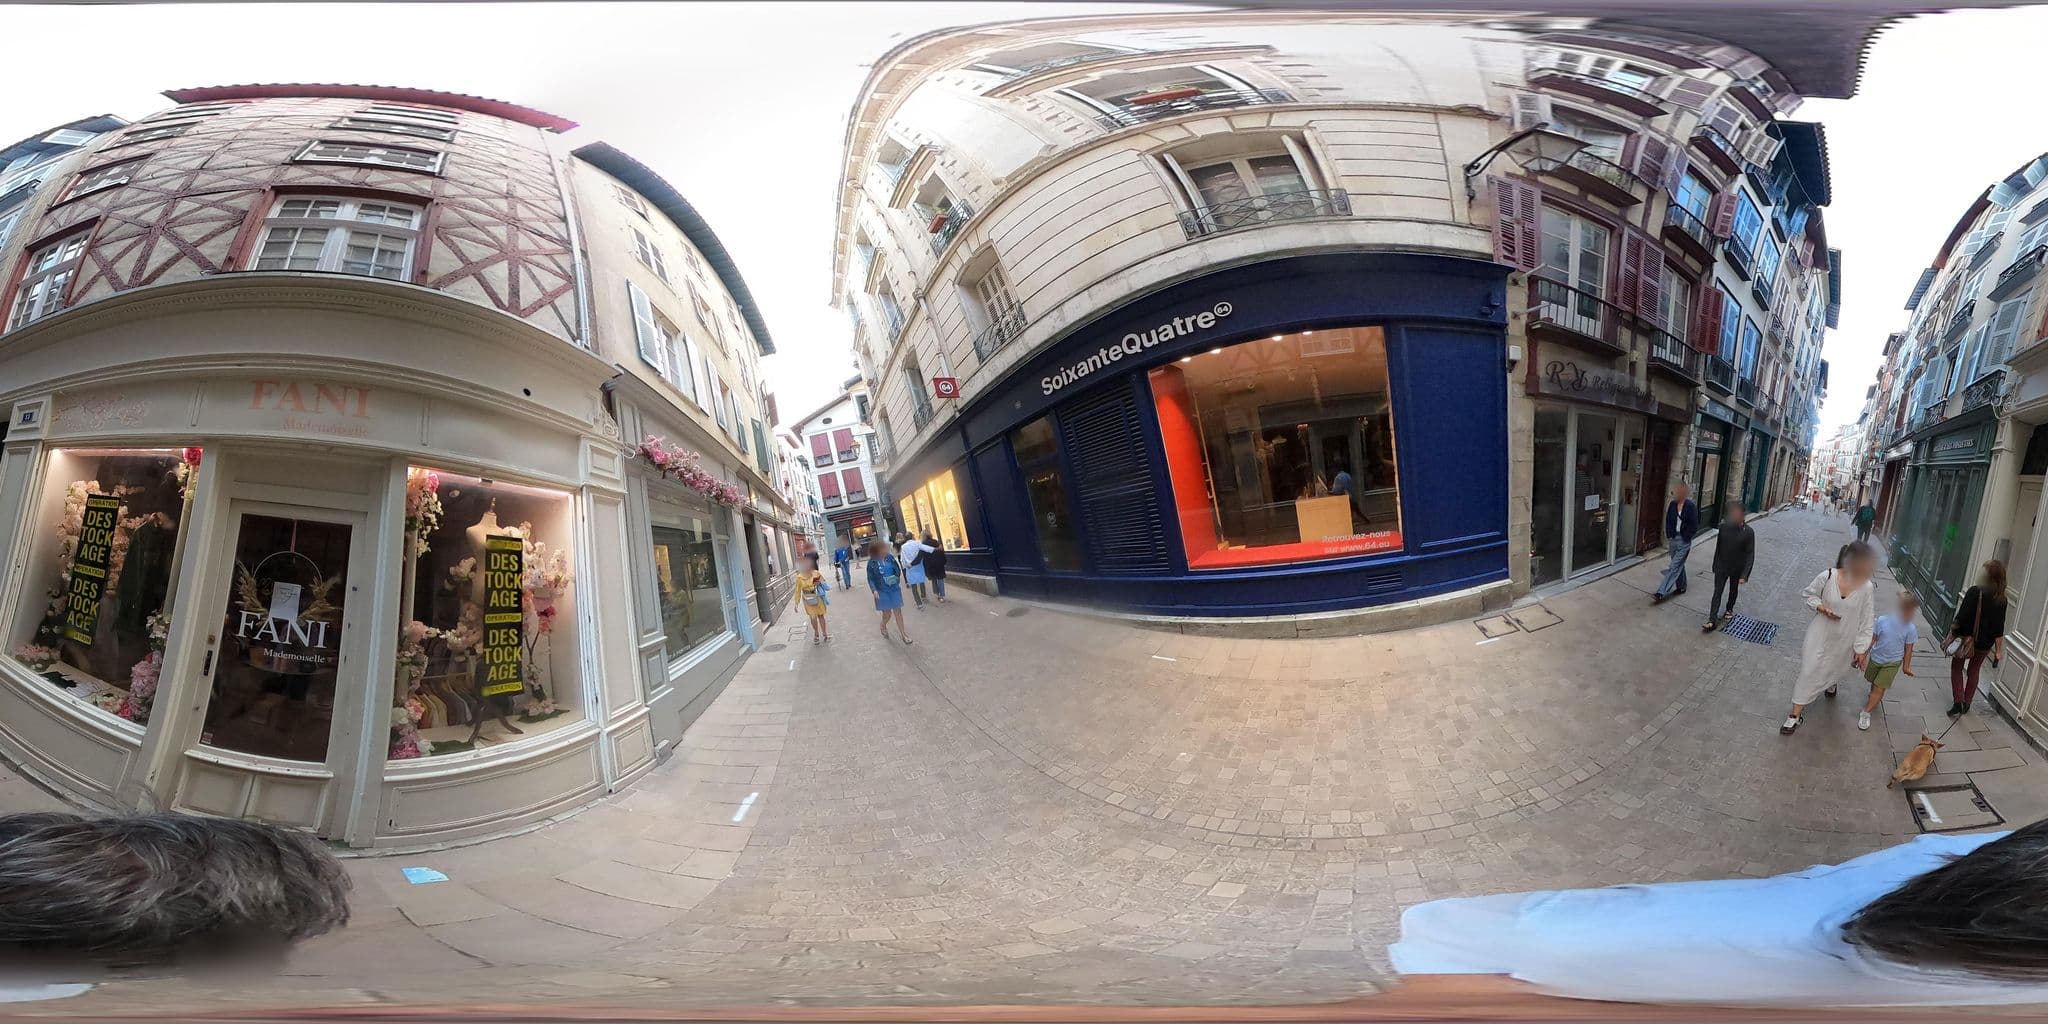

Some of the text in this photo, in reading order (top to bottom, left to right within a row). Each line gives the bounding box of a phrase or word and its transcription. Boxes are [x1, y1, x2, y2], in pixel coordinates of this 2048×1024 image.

[1041, 310, 1216, 395] SoixanteQuatre
[248, 379, 376, 418] FANI
[281, 418, 369, 437] Mademoiselle
[87, 510, 113, 528] DES
[81, 526, 113, 547] TOCK
[1322, 530, 1391, 542] Retrouvez-nous
[80, 544, 106, 563] AGE
[491, 553, 518, 571] DES
[73, 577, 99, 599] DES
[486, 571, 522, 589] TOCK
[68, 592, 100, 618] TOCK
[489, 590, 519, 608] AGE
[66, 613, 94, 632] AGE
[236, 610, 330, 648] FANI
[489, 628, 518, 646] DES
[263, 648, 326, 663] Mademoiselle
[485, 646, 522, 665] TOCK
[487, 664, 518, 682] AGE
